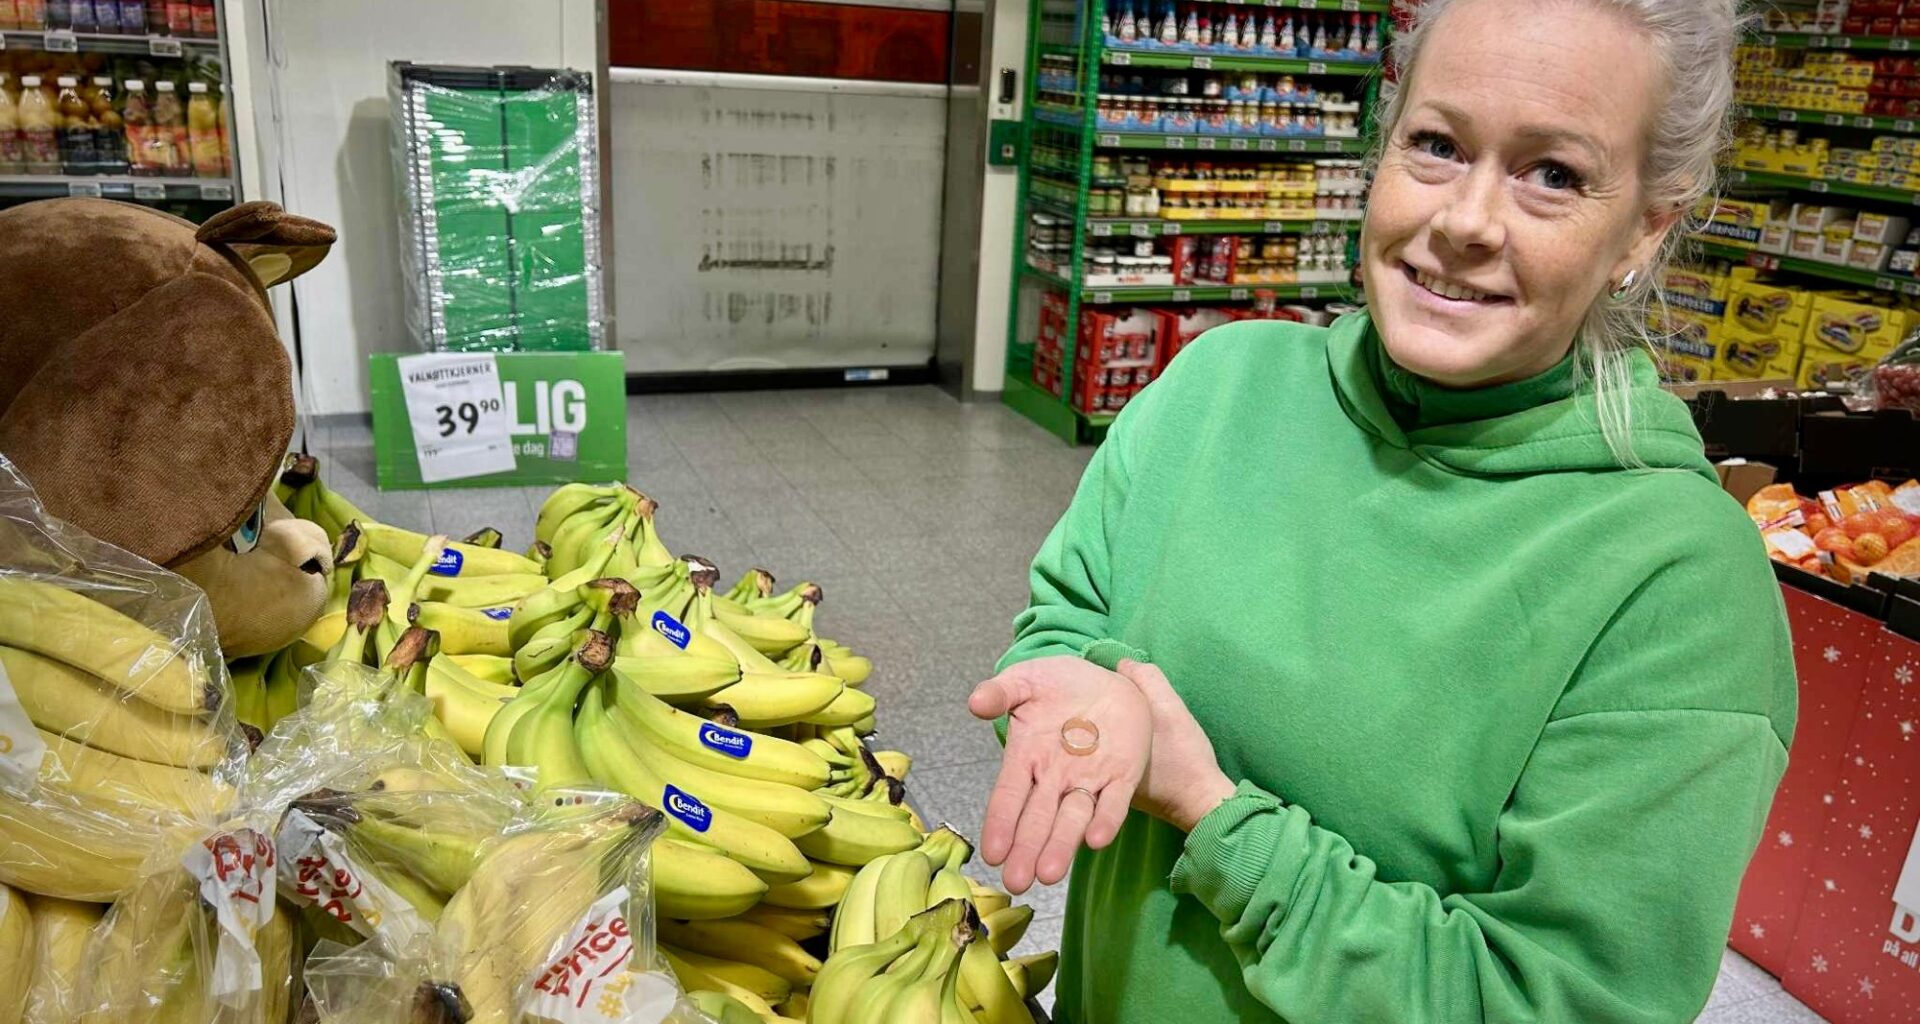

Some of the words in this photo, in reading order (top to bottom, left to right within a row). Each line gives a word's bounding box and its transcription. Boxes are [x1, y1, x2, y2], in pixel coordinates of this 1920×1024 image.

[408, 363, 491, 383] VALNØTTKJERNER
[523, 440, 545, 458] dag
[437, 554, 457, 565] endit
[661, 622, 685, 641] Bendit
[713, 732, 745, 747] Bendit
[677, 797, 705, 817] Bendit
[1882, 939, 1900, 958] på
